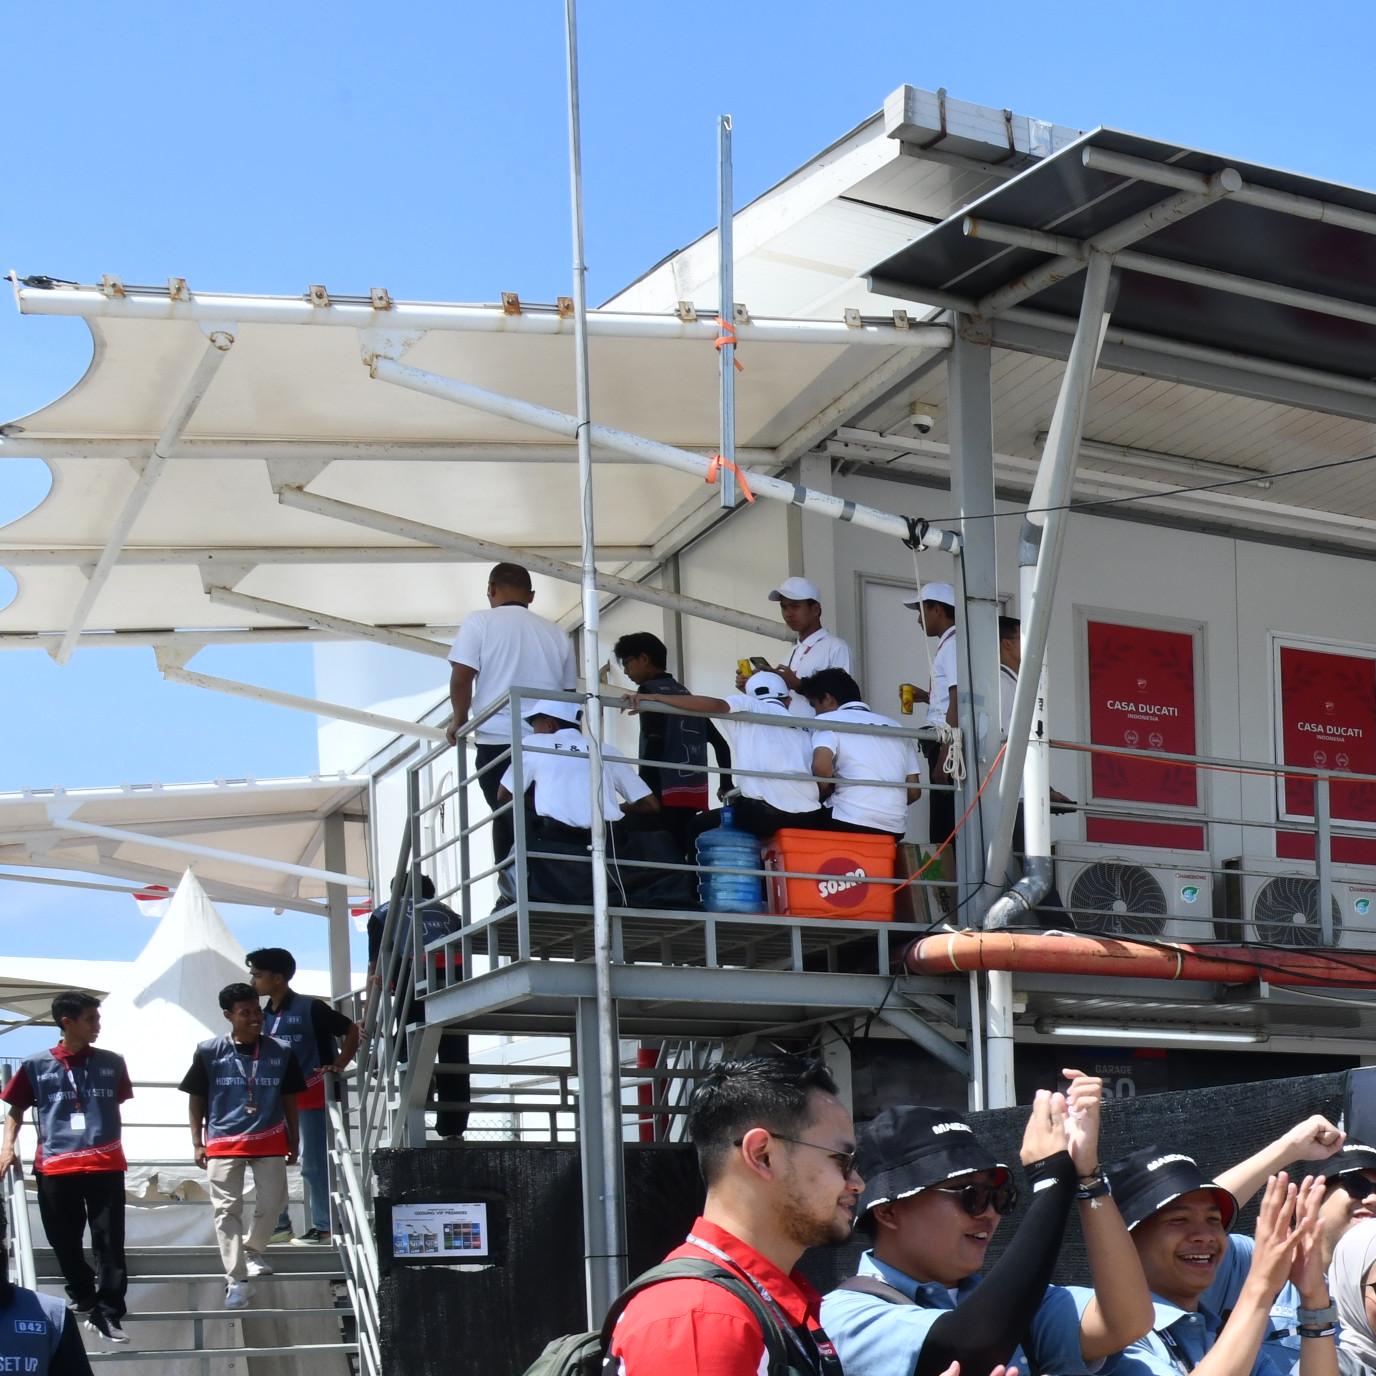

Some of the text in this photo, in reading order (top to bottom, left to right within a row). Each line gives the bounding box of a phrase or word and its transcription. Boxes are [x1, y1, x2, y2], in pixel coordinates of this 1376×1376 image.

[1107, 700, 1178, 717] CASA DUCATI
[1297, 722, 1363, 738] CASA DUCATI
[818, 868, 866, 898] SOSRO
[1095, 1064, 1133, 1075] GARAGE
[19, 1322, 42, 1332] 042
[25, 1357, 39, 1372] UP
